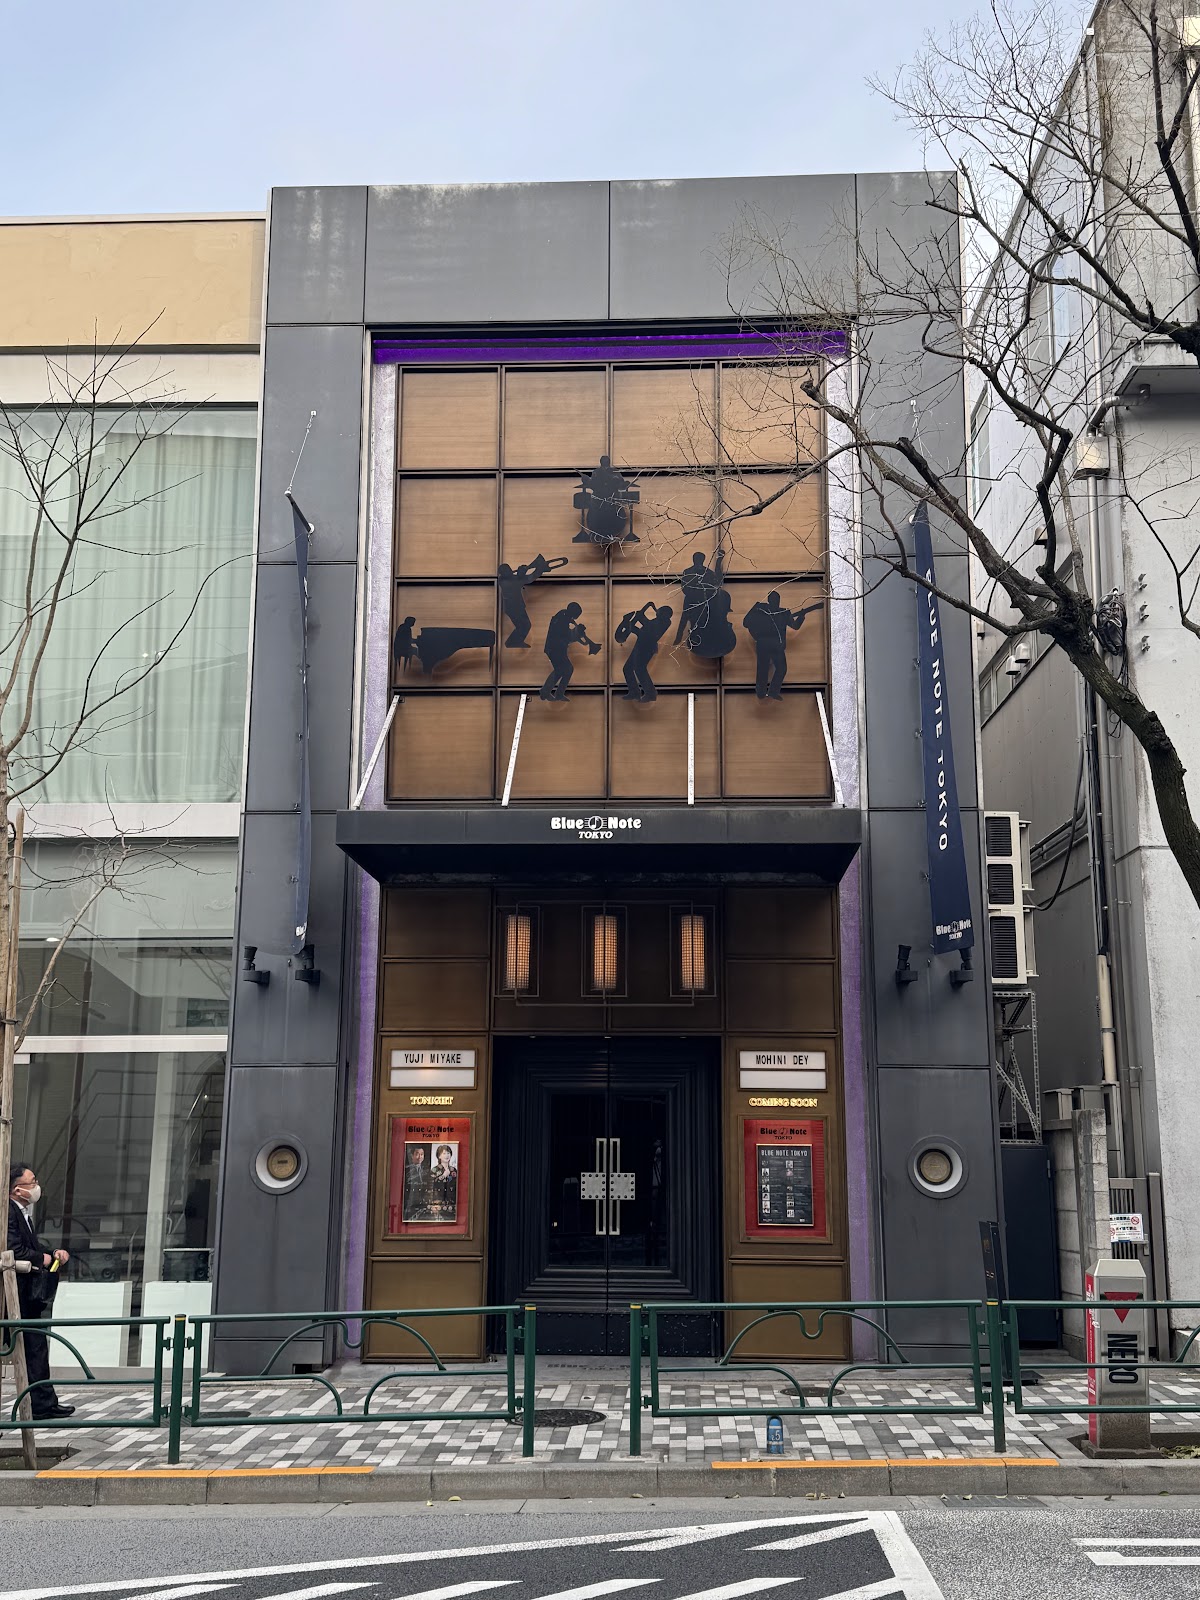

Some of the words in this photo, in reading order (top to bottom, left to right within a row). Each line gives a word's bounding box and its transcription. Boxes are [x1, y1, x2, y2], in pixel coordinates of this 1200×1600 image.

[925, 567, 939, 648] BLUE
[931, 657, 943, 739] NOTE
[937, 749, 948, 851] TOKYO
[551, 816, 584, 830] Blue
[607, 816, 642, 830] Note
[578, 831, 613, 839] TOKYO
[935, 924, 951, 936] Blue
[958, 918, 972, 931] Note
[404, 1053, 424, 1064] YUJI
[430, 1053, 462, 1064] MIYAKE
[755, 1054, 787, 1065] MOHINI
[793, 1055, 809, 1065] DEY
[410, 1096, 454, 1105] TONIGHT
[748, 1097, 790, 1108] COMING
[790, 1098, 818, 1108] SOON
[408, 1125, 425, 1133] Blue
[437, 1125, 455, 1133] Note
[760, 1127, 778, 1135] Blue
[789, 1127, 807, 1136] Note
[761, 1149, 774, 1157] BLUE
[775, 1149, 789, 1157] NOTE
